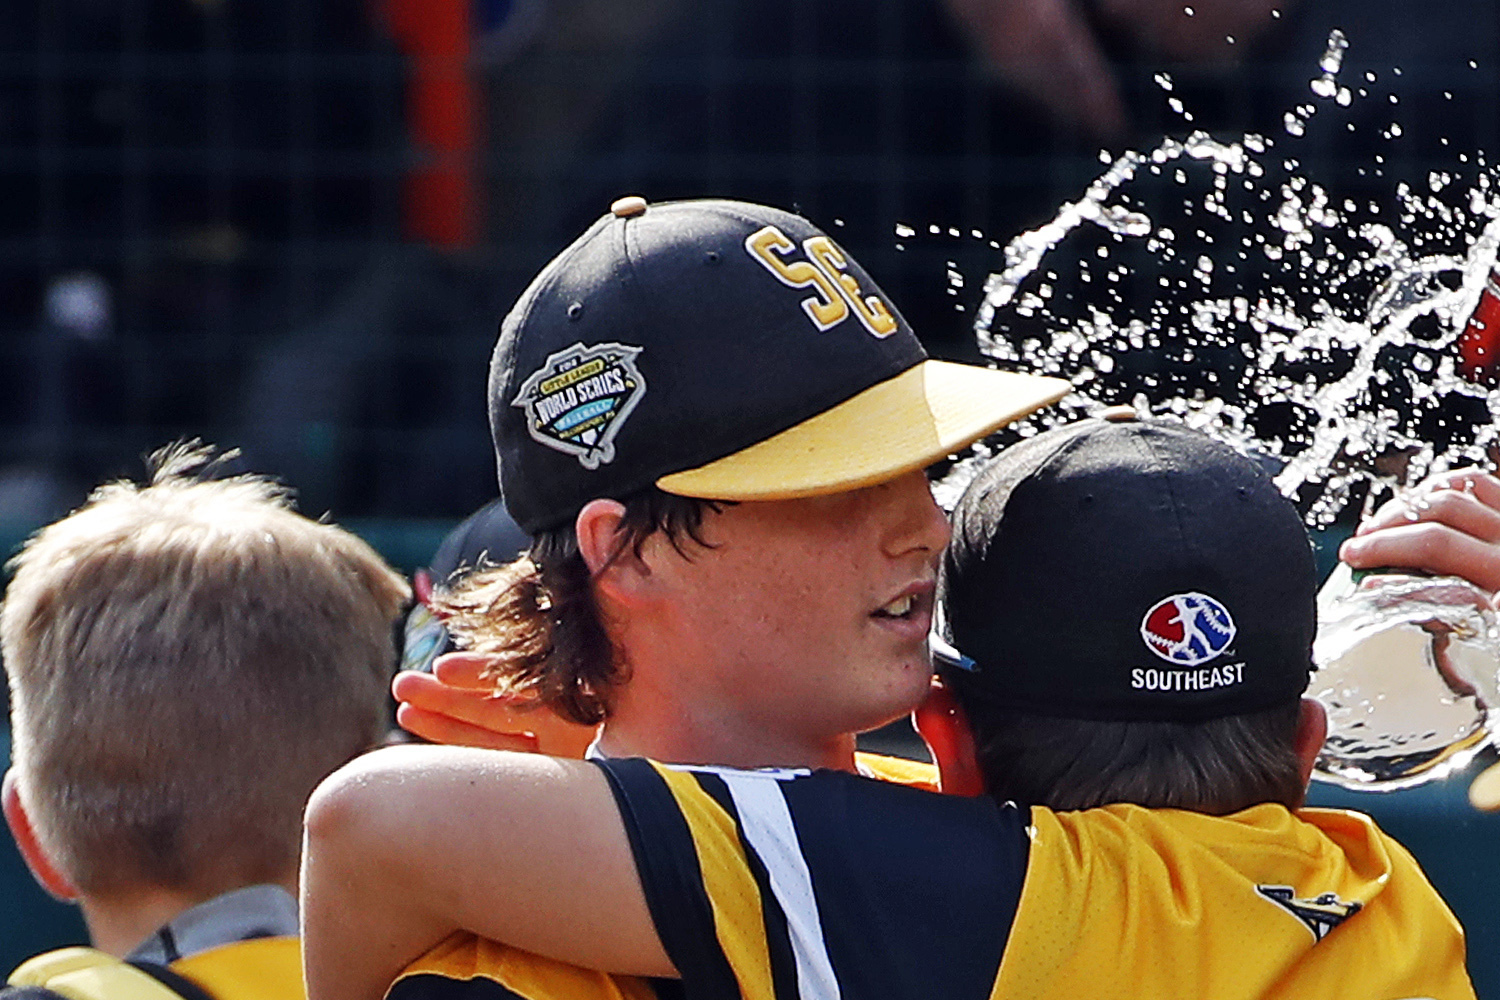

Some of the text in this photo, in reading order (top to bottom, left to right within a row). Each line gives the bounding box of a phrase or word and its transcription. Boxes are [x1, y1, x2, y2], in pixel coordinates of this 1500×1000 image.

[744, 224, 899, 340] SE
[534, 387, 578, 426] WORLD
[576, 367, 626, 403] SERIES
[1131, 662, 1246, 692] SOUTHEAST
